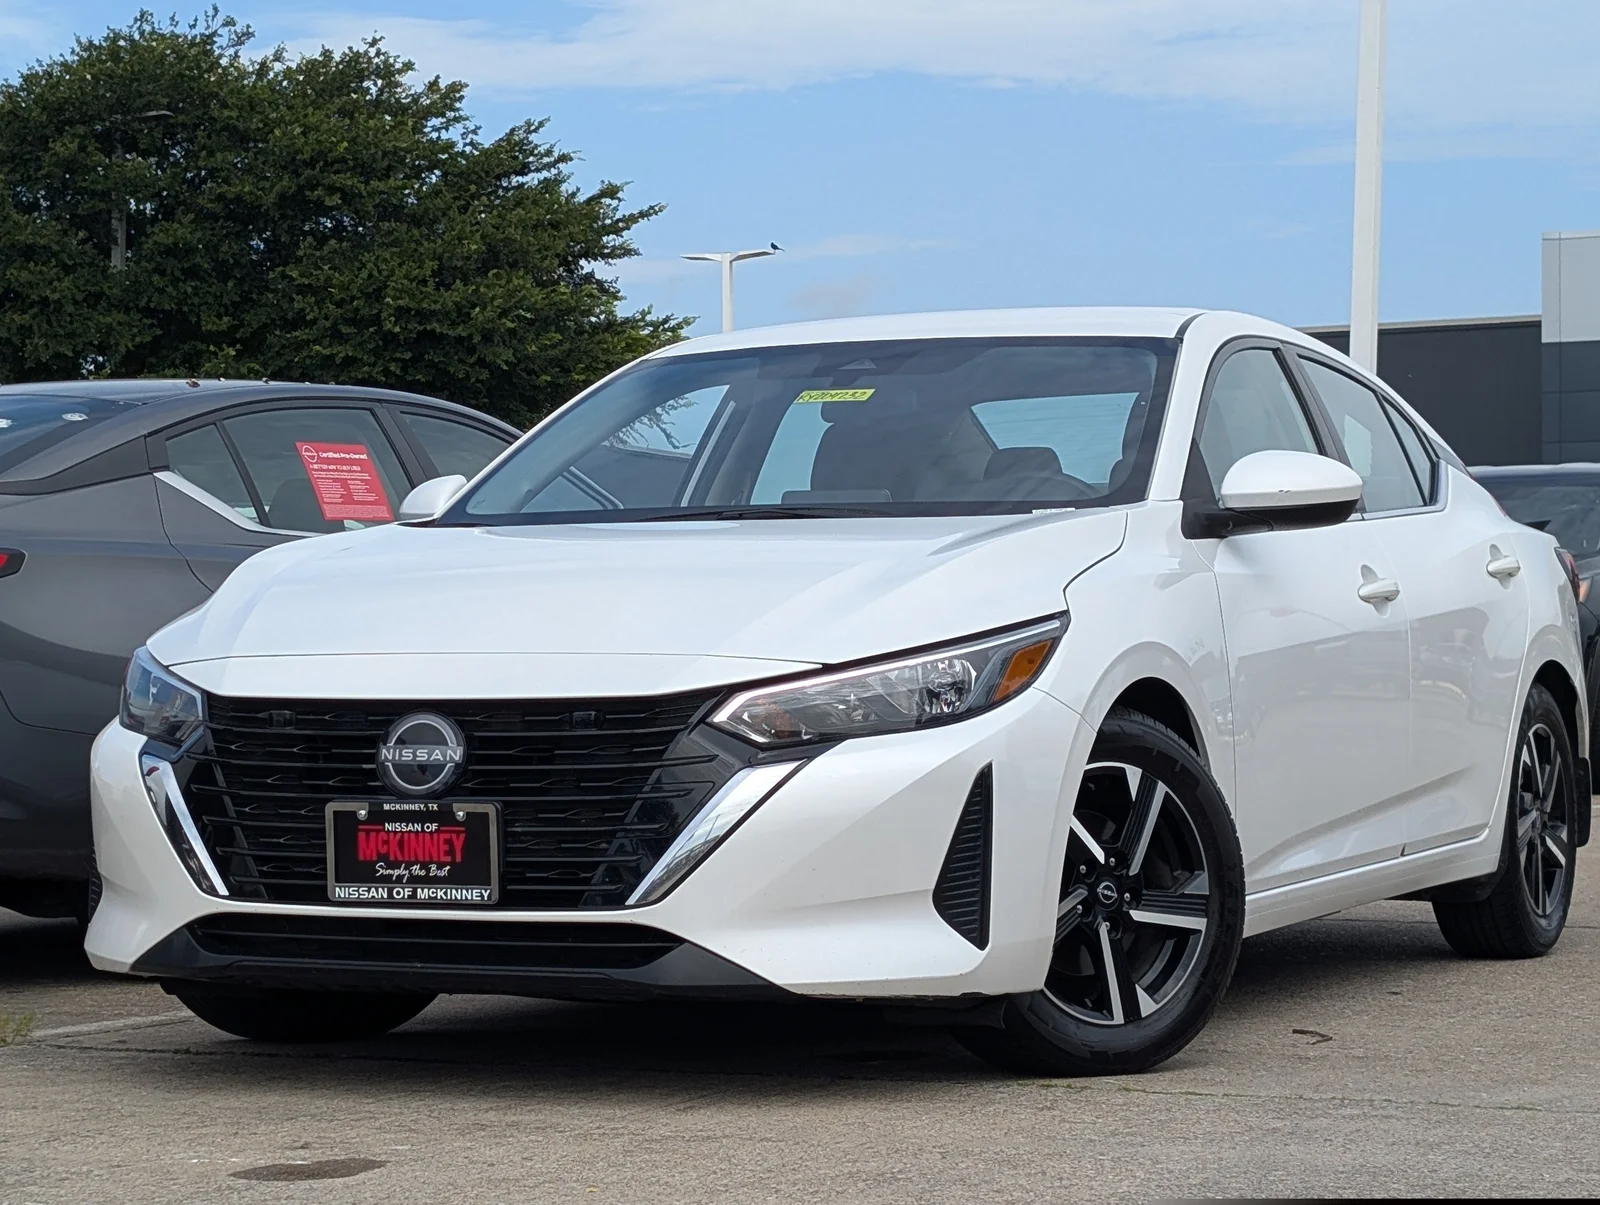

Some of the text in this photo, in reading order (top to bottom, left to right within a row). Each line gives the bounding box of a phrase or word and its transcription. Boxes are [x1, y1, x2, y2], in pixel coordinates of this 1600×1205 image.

[381, 748, 461, 761] NISSAN
[383, 803, 439, 811] MCKINNEY, TX
[384, 822, 439, 832] NISSAN OF
[375, 862, 451, 883] Simply the Best
[335, 887, 388, 899] NISSAN
[392, 888, 413, 899] OF
